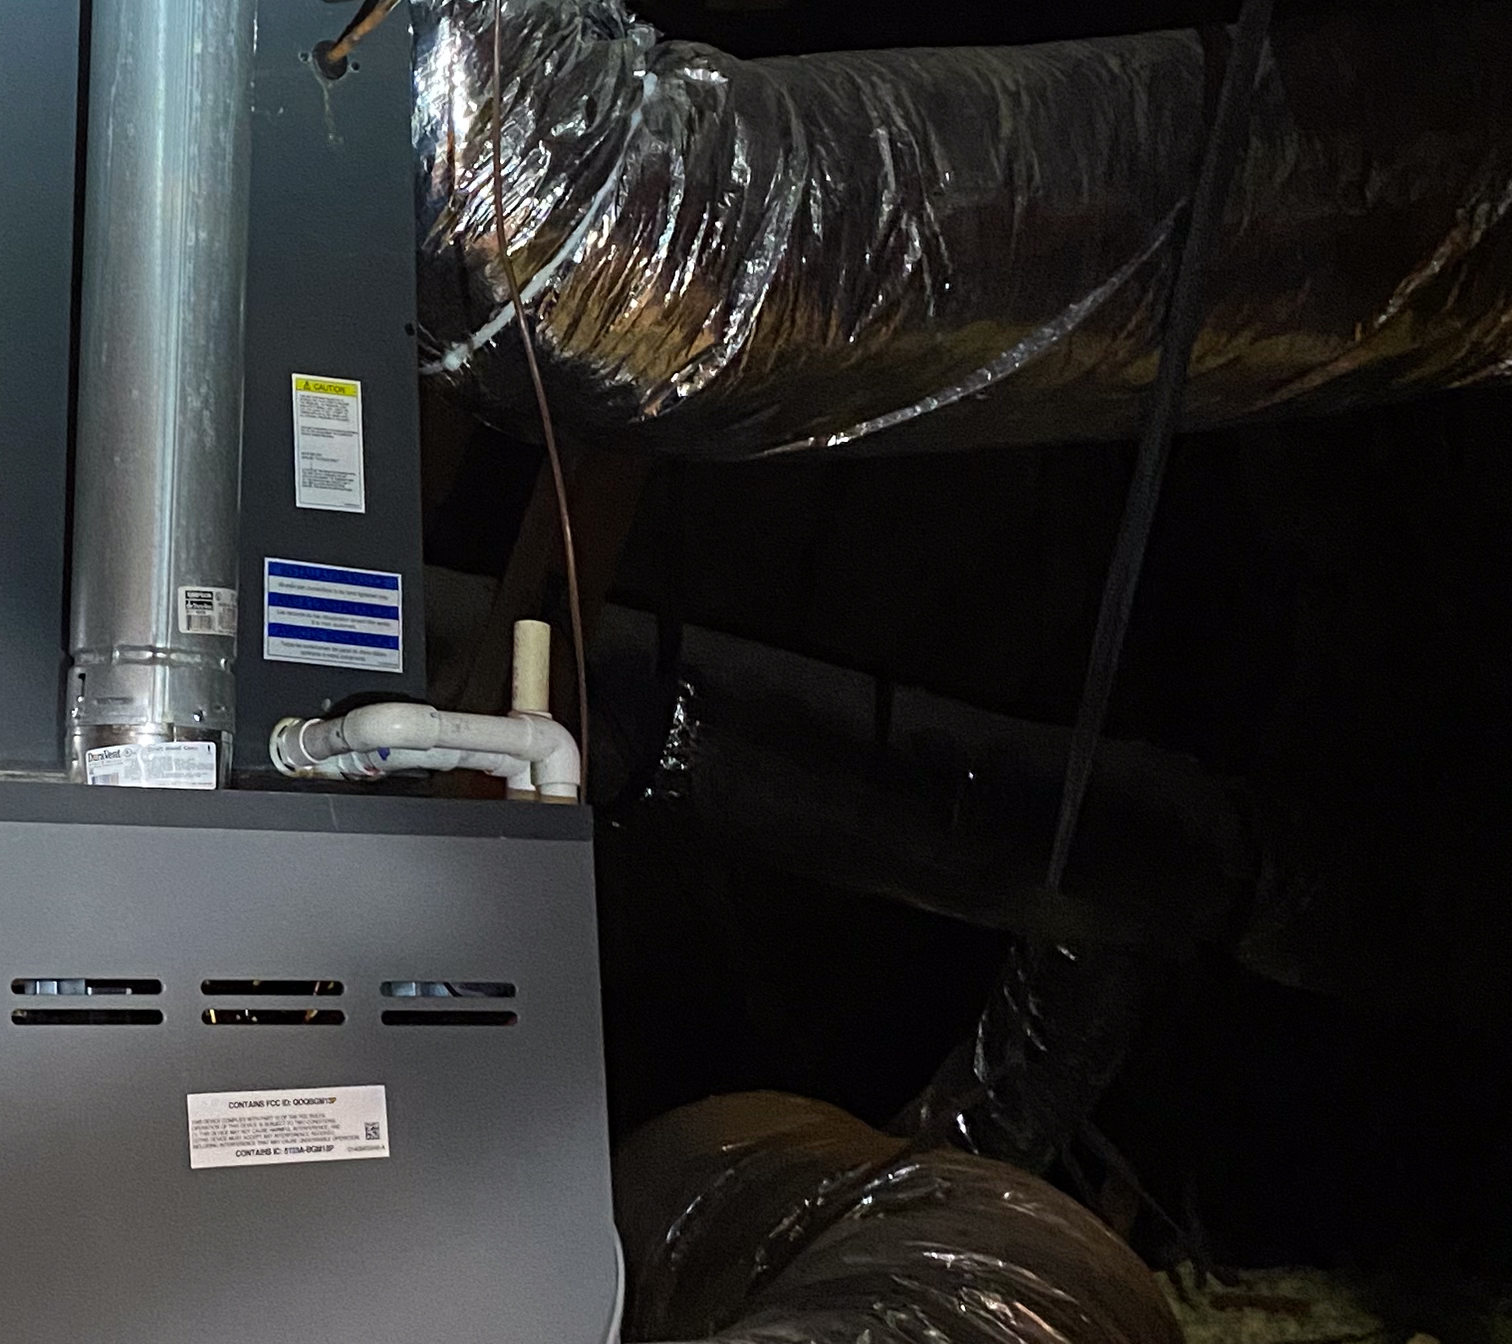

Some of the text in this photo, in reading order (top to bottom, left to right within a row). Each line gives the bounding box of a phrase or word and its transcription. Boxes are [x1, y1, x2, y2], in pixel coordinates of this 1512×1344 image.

[314, 383, 345, 394] CAUTION
[228, 1100, 264, 1108] CONTAINS
[266, 1099, 280, 1107] FCC
[235, 1148, 271, 1157] CONTAINS
